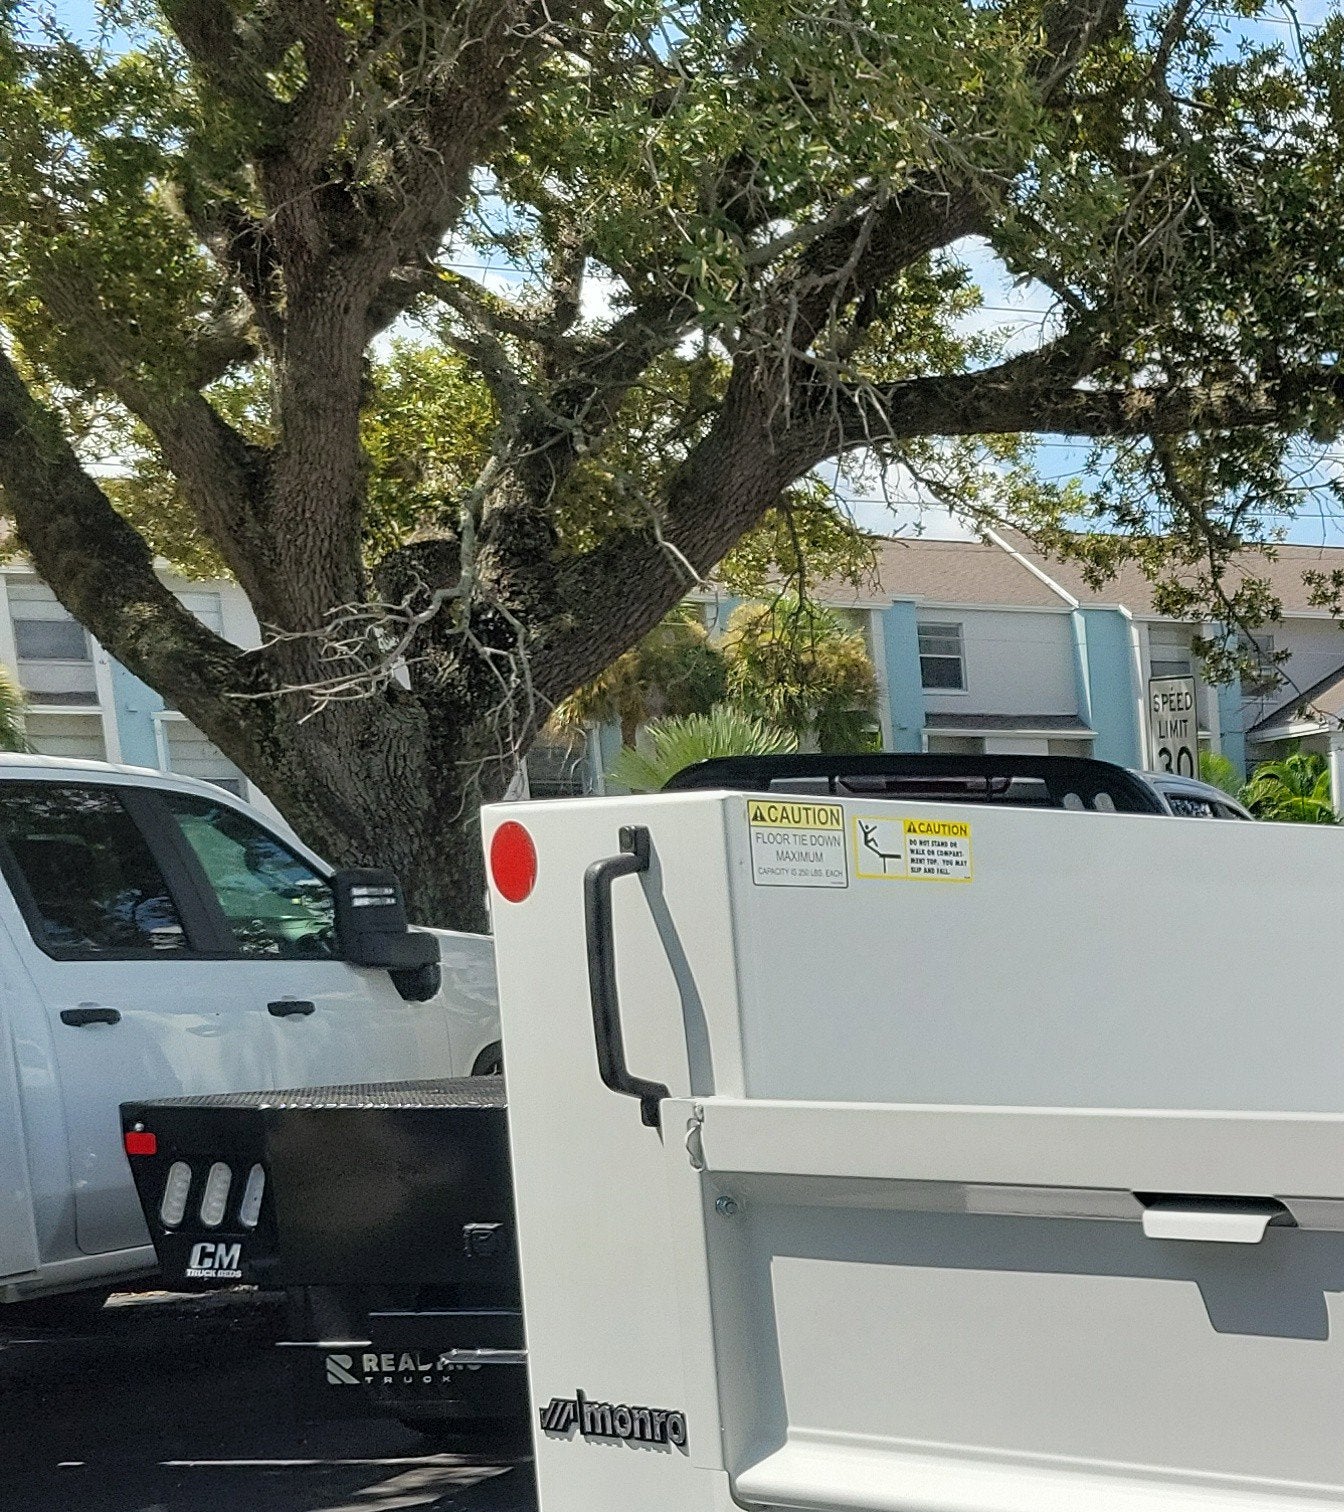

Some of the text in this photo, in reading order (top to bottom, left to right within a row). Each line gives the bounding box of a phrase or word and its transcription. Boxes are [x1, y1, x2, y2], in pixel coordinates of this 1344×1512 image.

[1153, 692, 1193, 712] SPEED
[1158, 719, 1188, 739] LIMIT
[1158, 746, 1194, 779] 30
[767, 805, 840, 826] CAUTION
[918, 822, 967, 836] CAUTION
[755, 832, 841, 847] FLOOR TIE DOWN
[776, 850, 824, 863] MAXIMUM
[190, 1242, 242, 1270] CM
